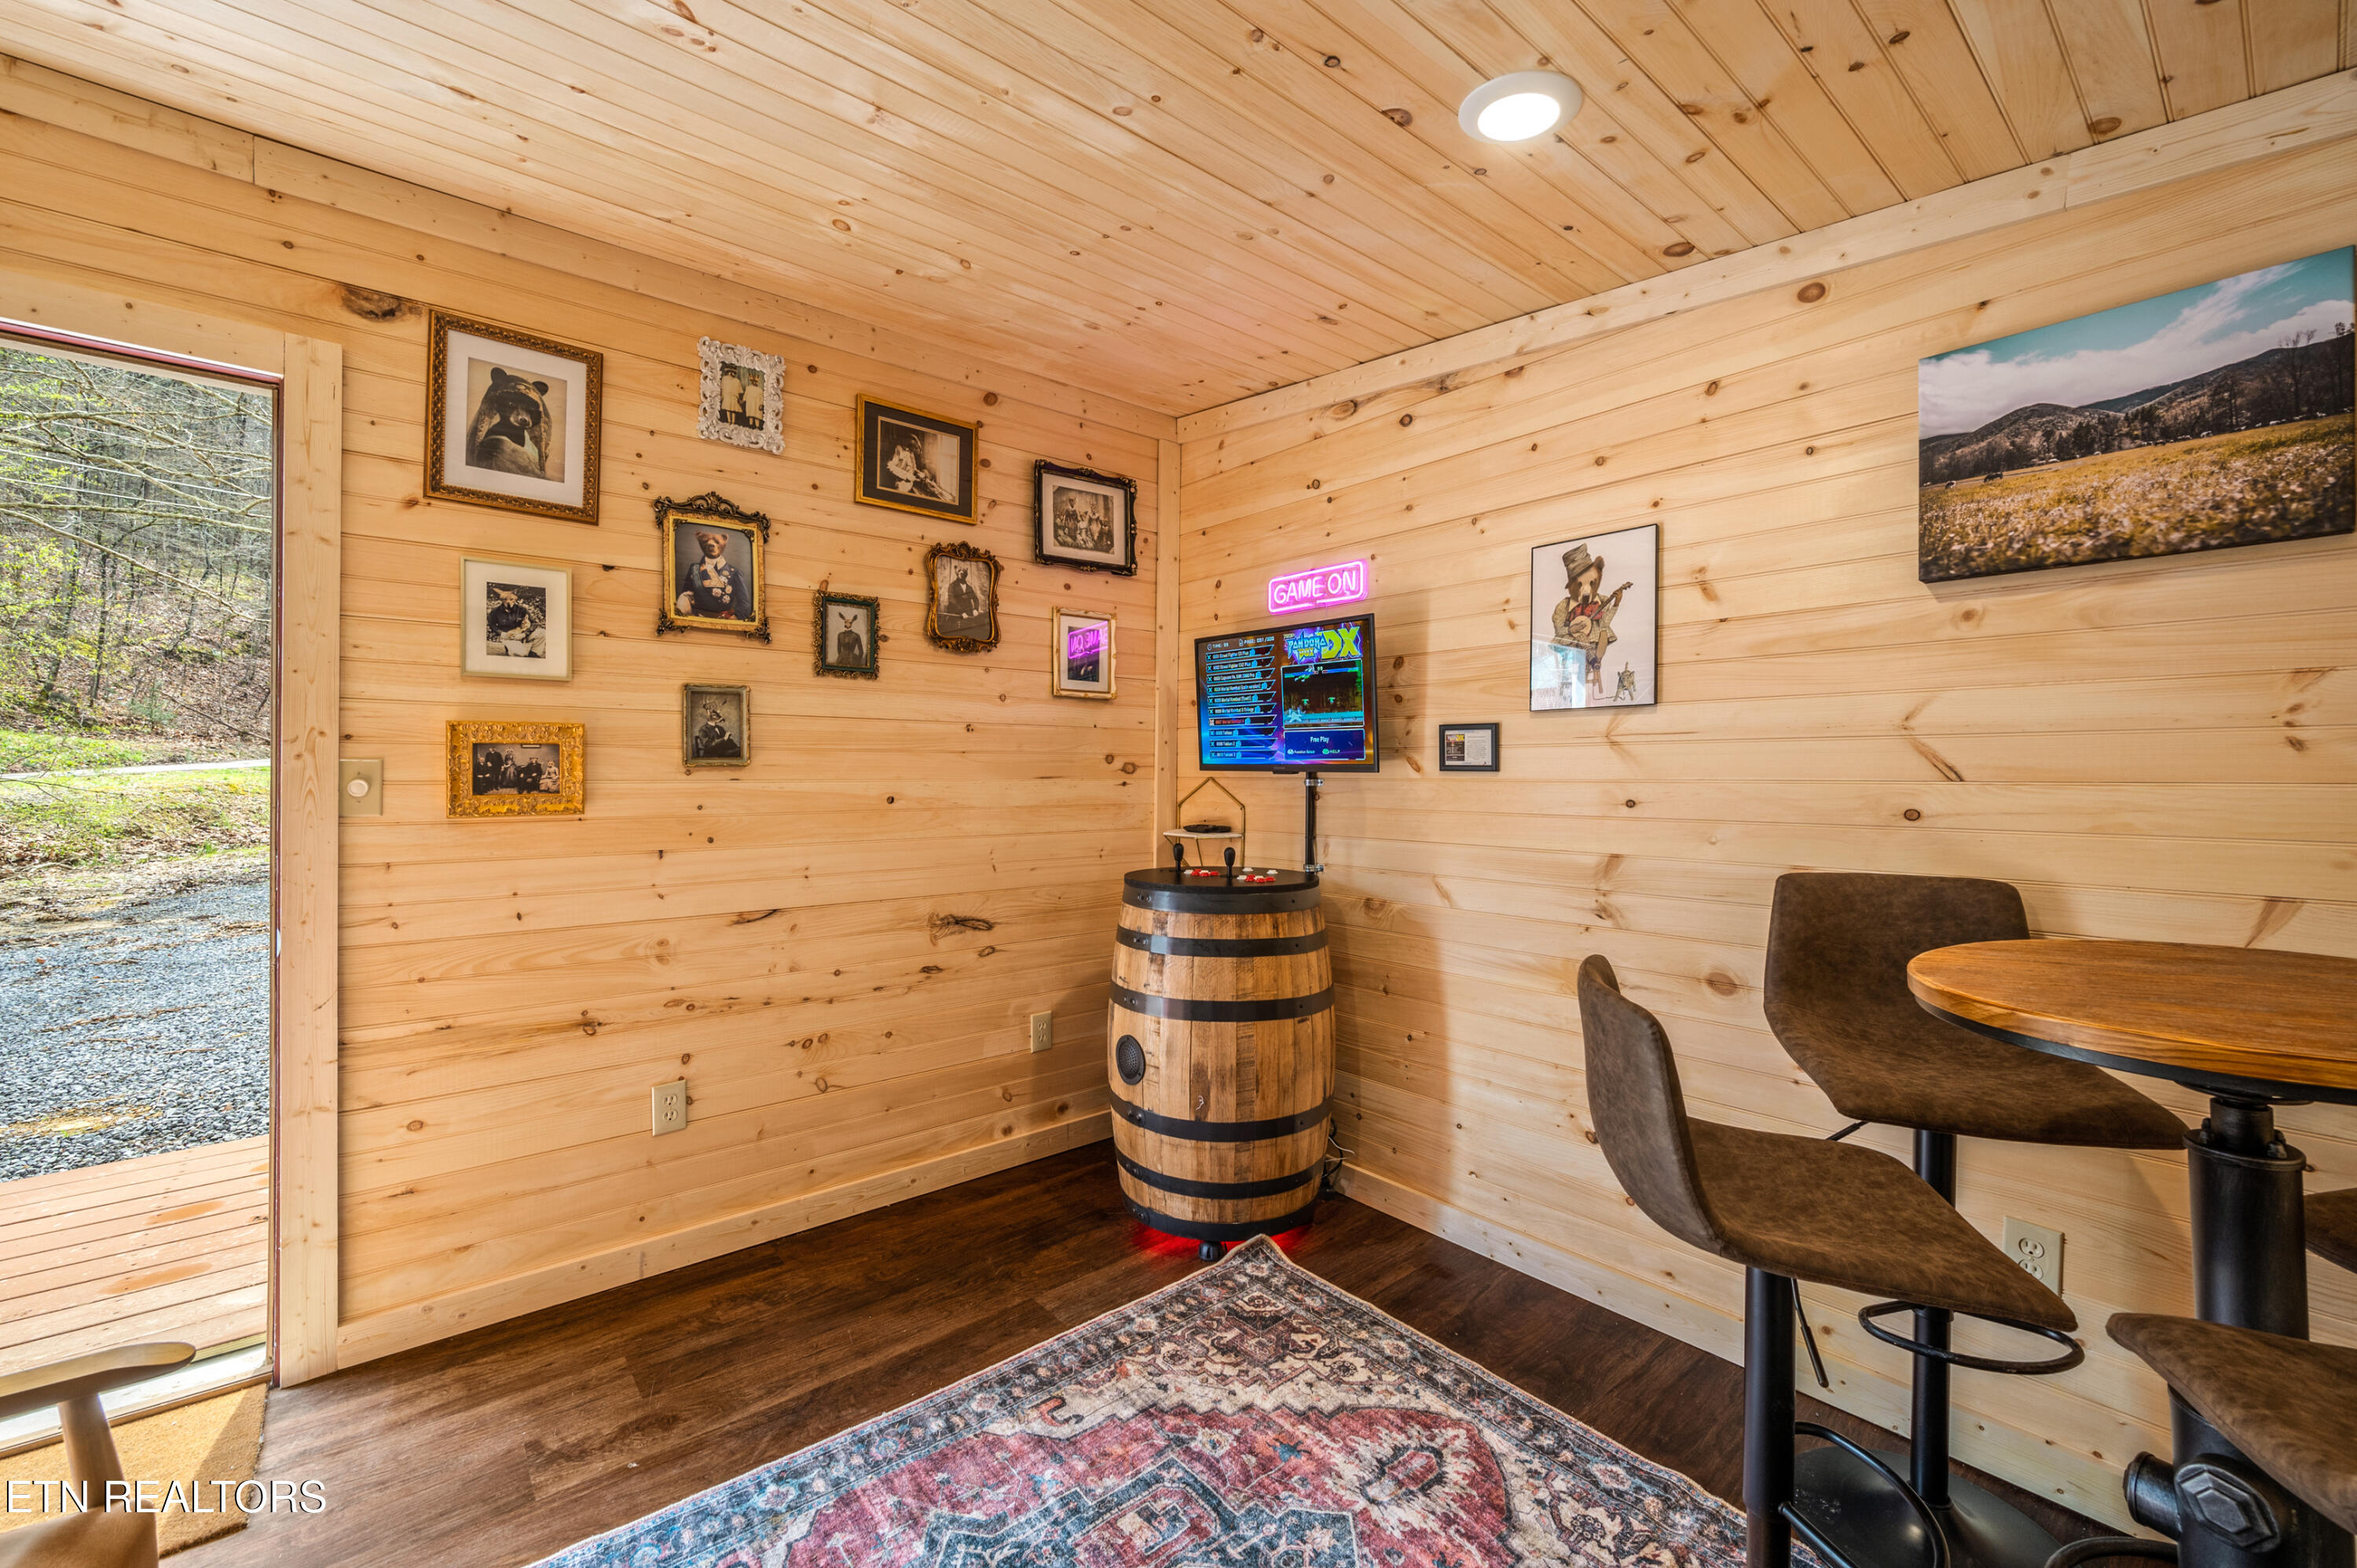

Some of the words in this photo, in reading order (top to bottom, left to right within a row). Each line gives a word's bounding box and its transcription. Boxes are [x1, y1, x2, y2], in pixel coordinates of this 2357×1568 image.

[1274, 576, 1325, 604] GAME
[1328, 570, 1358, 595] ON
[1316, 626, 1362, 660] DX
